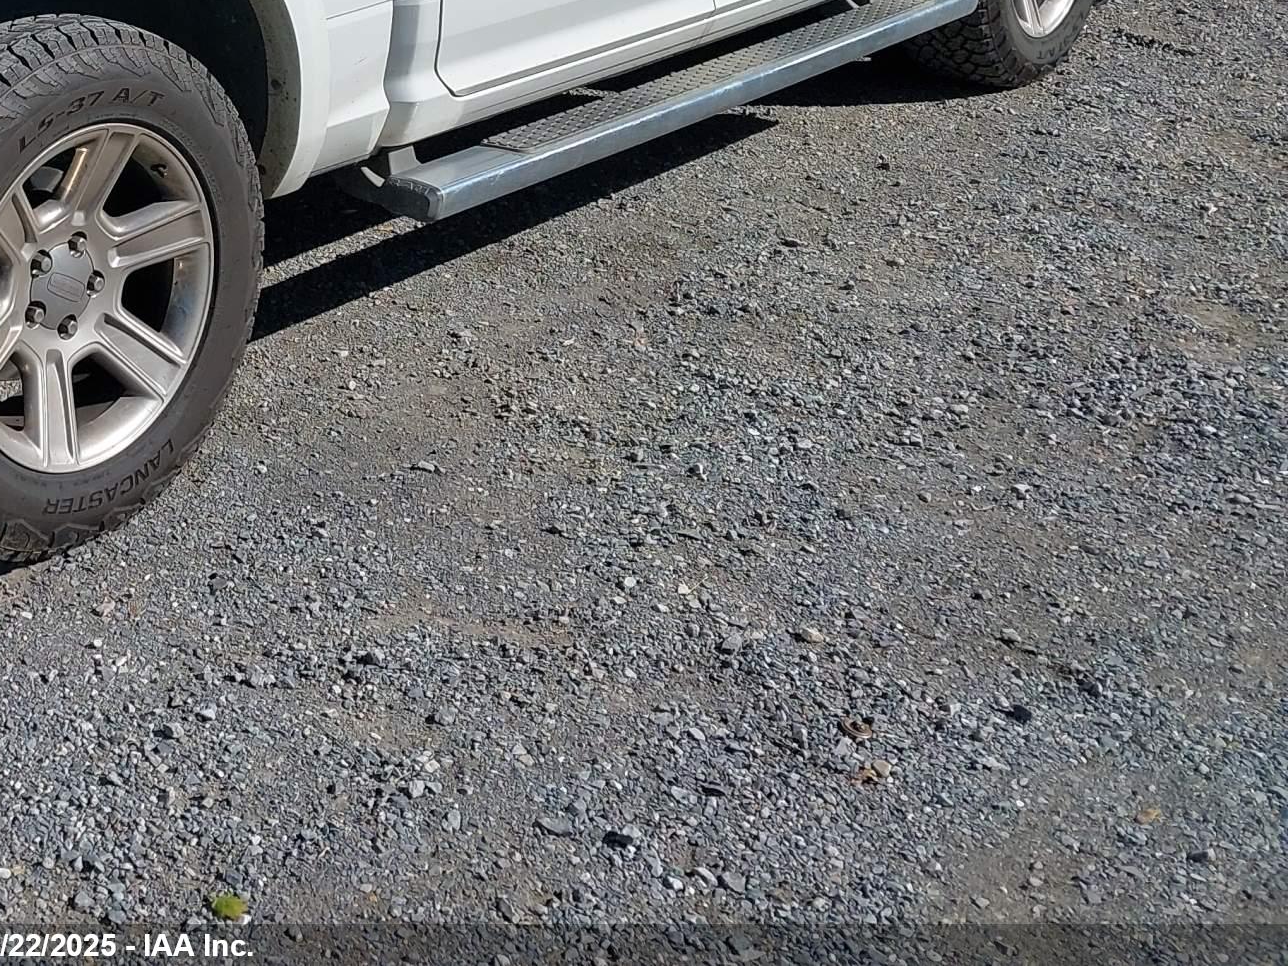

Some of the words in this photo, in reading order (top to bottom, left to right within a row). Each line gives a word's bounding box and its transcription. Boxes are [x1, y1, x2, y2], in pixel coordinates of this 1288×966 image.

[18, 90, 105, 154] LS-37
[111, 88, 166, 107] A/T
[42, 439, 175, 515] LANCASTER
